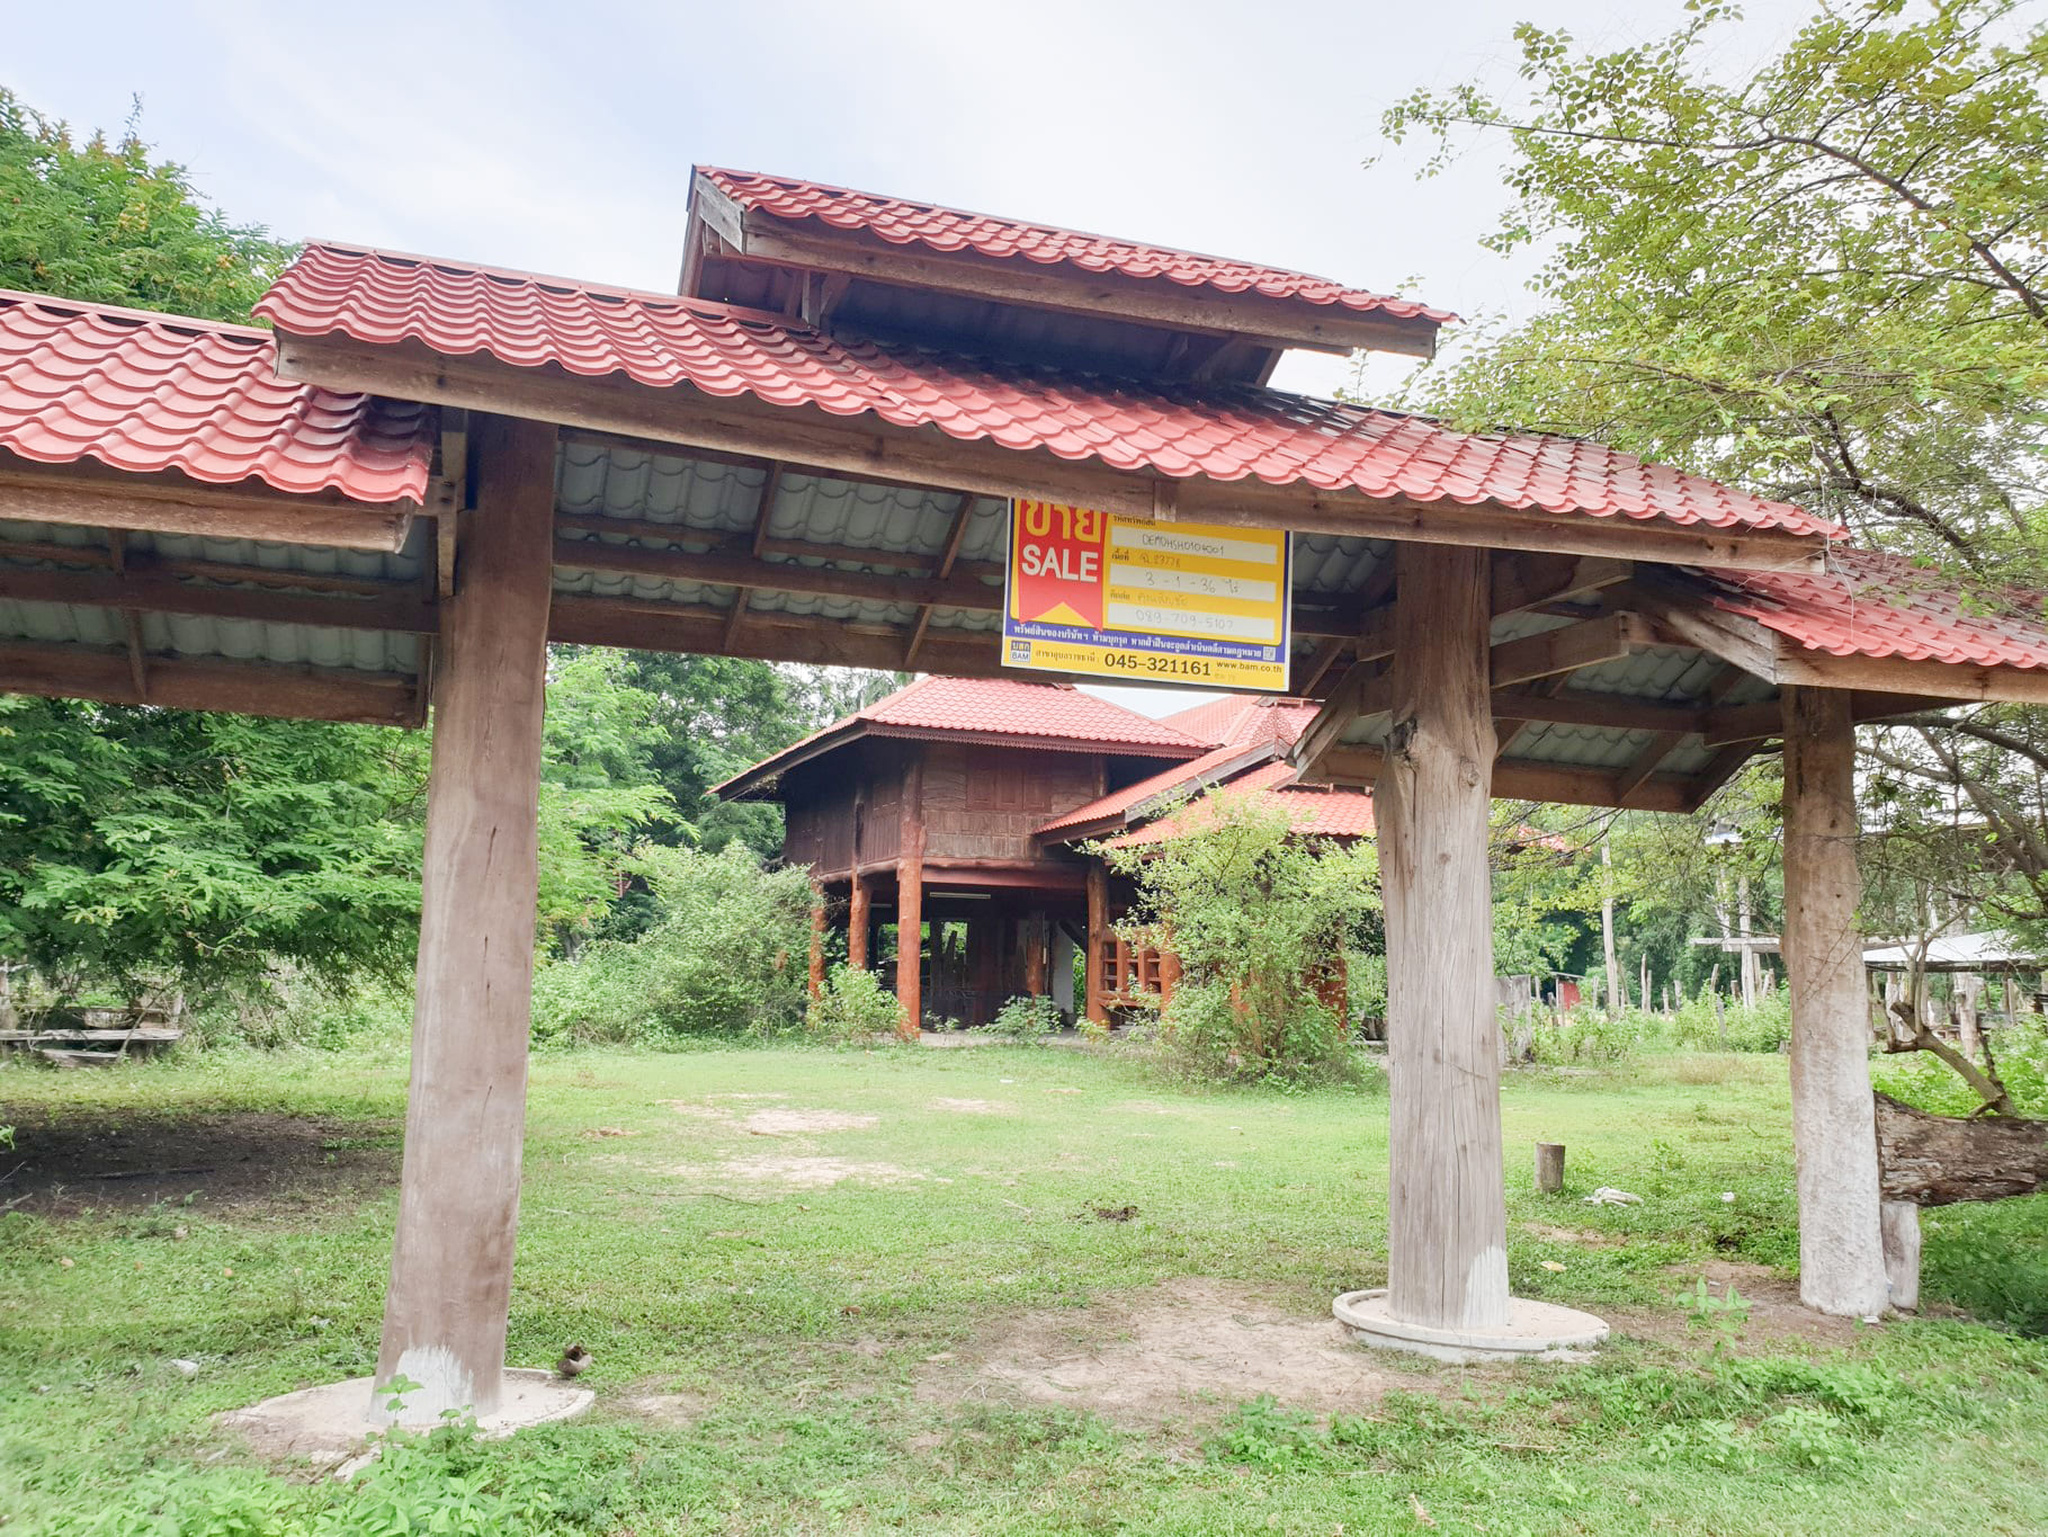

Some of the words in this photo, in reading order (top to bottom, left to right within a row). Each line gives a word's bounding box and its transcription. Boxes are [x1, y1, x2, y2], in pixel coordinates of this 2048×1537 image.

[1026, 500, 1101, 543] ขาย
[1022, 544, 1099, 583] SALE
[1011, 651, 1030, 661] BAM
[1104, 652, 1211, 677] 045-321161
[1216, 660, 1283, 674] www.bam.co.th
